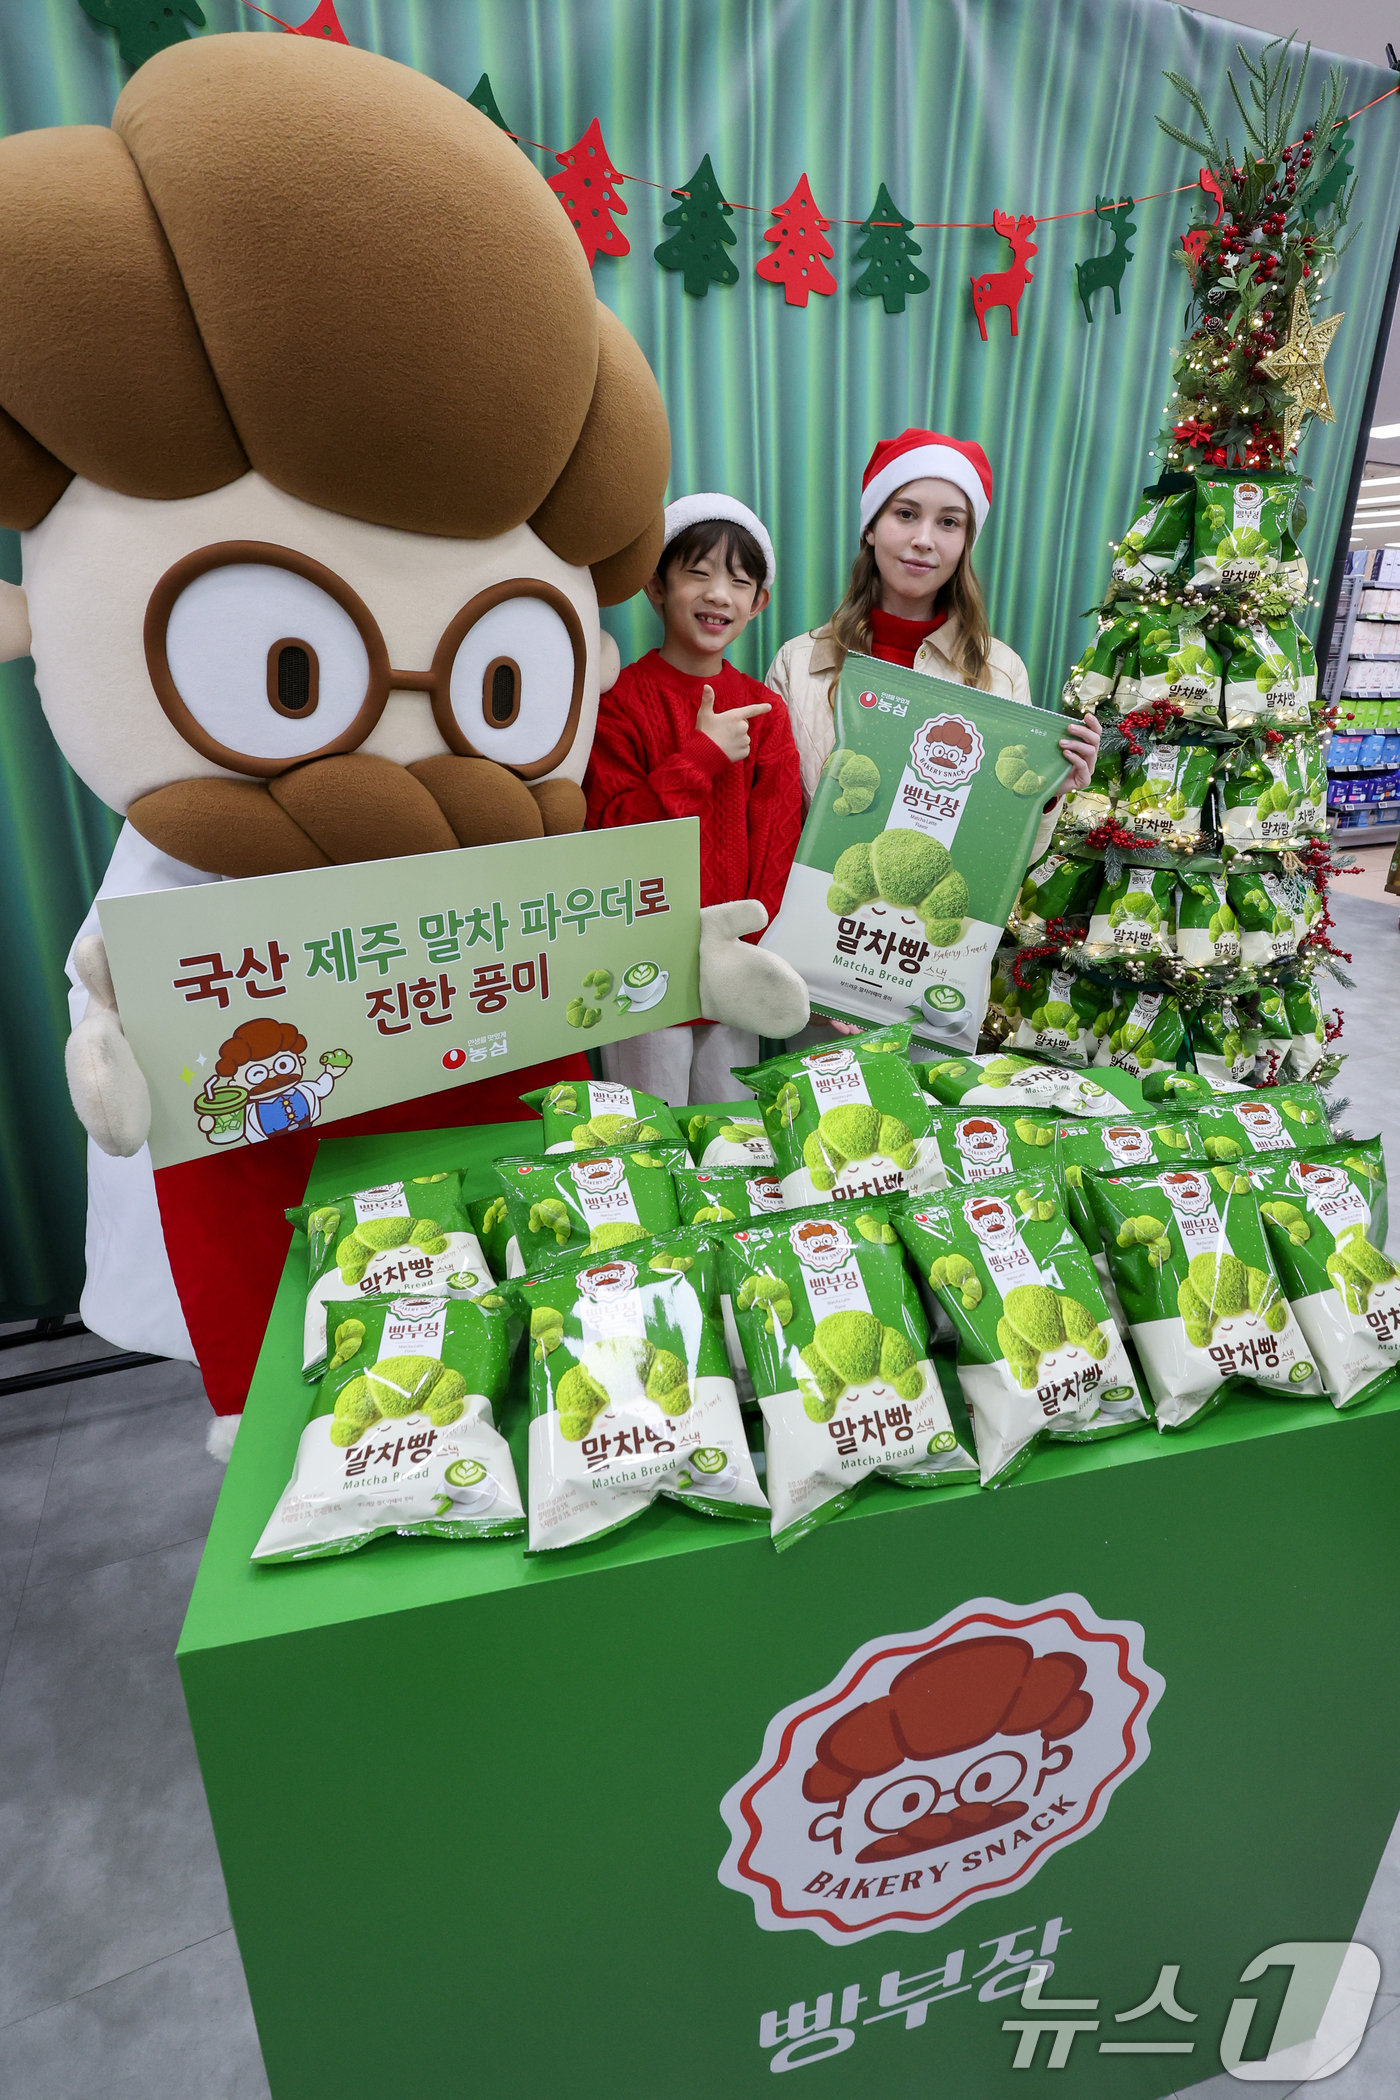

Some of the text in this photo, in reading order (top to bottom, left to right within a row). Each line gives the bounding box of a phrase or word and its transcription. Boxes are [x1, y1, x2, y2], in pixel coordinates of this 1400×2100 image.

[1168, 684, 1208, 700] 말차빵
[1266, 691, 1296, 707] 말차빵
[878, 698, 908, 718] 농심
[920, 757, 966, 778] BAKERY SNACK
[903, 784, 960, 818] 빵부장
[910, 814, 938, 827] Matcha Latte
[1133, 816, 1174, 832] 말차빵
[1261, 821, 1290, 836] 말차빵
[173, 876, 670, 1010] 국산 제주 말차 파우더로
[836, 917, 930, 974] 말차빵
[1114, 929, 1153, 947] 말차빵
[931, 942, 988, 962] Bakery Snack
[1214, 942, 1238, 957] 말차빵
[1271, 942, 1296, 957] 말차빵
[832, 954, 913, 988] Matcha Bread
[923, 966, 947, 981] 스낵
[365, 953, 549, 1036] 진한 풍미
[467, 1031, 506, 1046] 인생을 맛있게
[1035, 1034, 1070, 1051] 말차빵
[468, 1039, 508, 1062] 농심
[816, 1072, 860, 1093] 빵부장
[593, 1092, 629, 1104] 빵부장
[967, 1145, 1002, 1155] BAKERY SNACK
[603, 1172, 617, 1183] SNACK
[584, 1192, 629, 1210] 빵부장
[1319, 1194, 1365, 1216] 빵부장
[1181, 1217, 1219, 1236] 빵부장
[807, 1252, 829, 1261] BAKERY
[988, 1249, 1030, 1273] 빵부장
[359, 1257, 434, 1296] 말차빵
[404, 1279, 434, 1290] Bread
[611, 1278, 630, 1292] SNACK
[809, 1271, 859, 1296] 빵부장
[388, 1322, 440, 1340] 빵부장
[1208, 1335, 1280, 1376] 말차빵
[1281, 1348, 1296, 1362] 스낵
[1036, 1363, 1103, 1416] 말차빵
[1100, 1375, 1117, 1387] 스낵
[828, 1403, 914, 1456] 말차빵
[916, 1418, 935, 1434] 스낵
[582, 1419, 676, 1473] 말차빵
[679, 1432, 702, 1447] 스낵
[345, 1429, 438, 1477] 말차빵
[840, 1444, 915, 1471] Matcha Bread
[342, 1471, 388, 1490] Matcha
[592, 1458, 677, 1490] Matcha Bread
[803, 1794, 1077, 1901] BAKERY SNACK
[758, 1915, 1073, 2074] 빵부장
